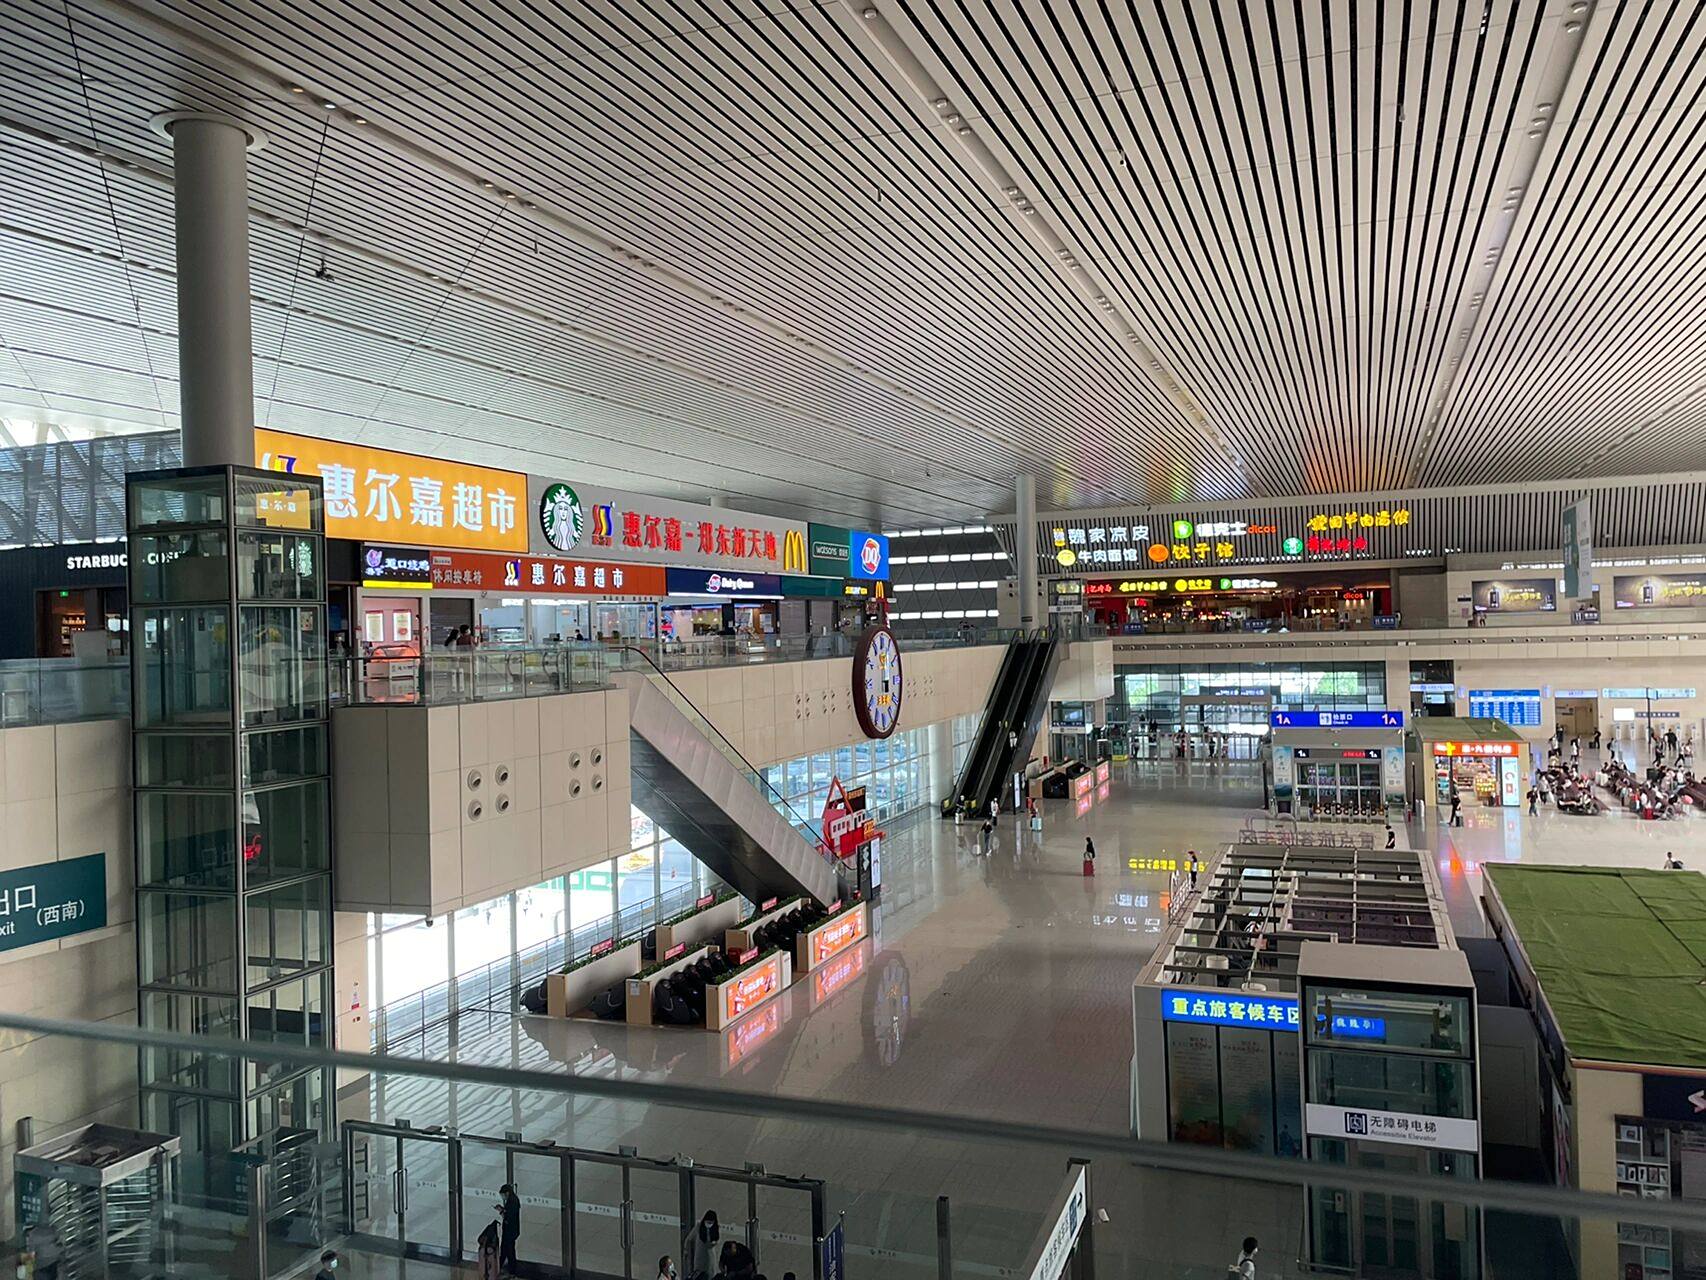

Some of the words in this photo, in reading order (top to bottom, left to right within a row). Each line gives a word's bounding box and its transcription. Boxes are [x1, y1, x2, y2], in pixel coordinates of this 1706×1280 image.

[317, 463, 516, 535] 惠尔嘉超市
[621, 511, 777, 561] 惠尔嘉-郑东新天地
[1247, 524, 1276, 535] dicos
[1078, 548, 1137, 564] 牛肉面馆
[1172, 542, 1234, 561] 饺子馆
[66, 554, 128, 570] STARBUC
[531, 563, 624, 589] 惠尔嘉超市
[1172, 997, 1299, 1024] 重点旅客候车区
[1370, 1115, 1437, 1134] 无障碍电梯
[1370, 1128, 1407, 1139] Accessible
[1408, 1132, 1437, 1142] Elevator
